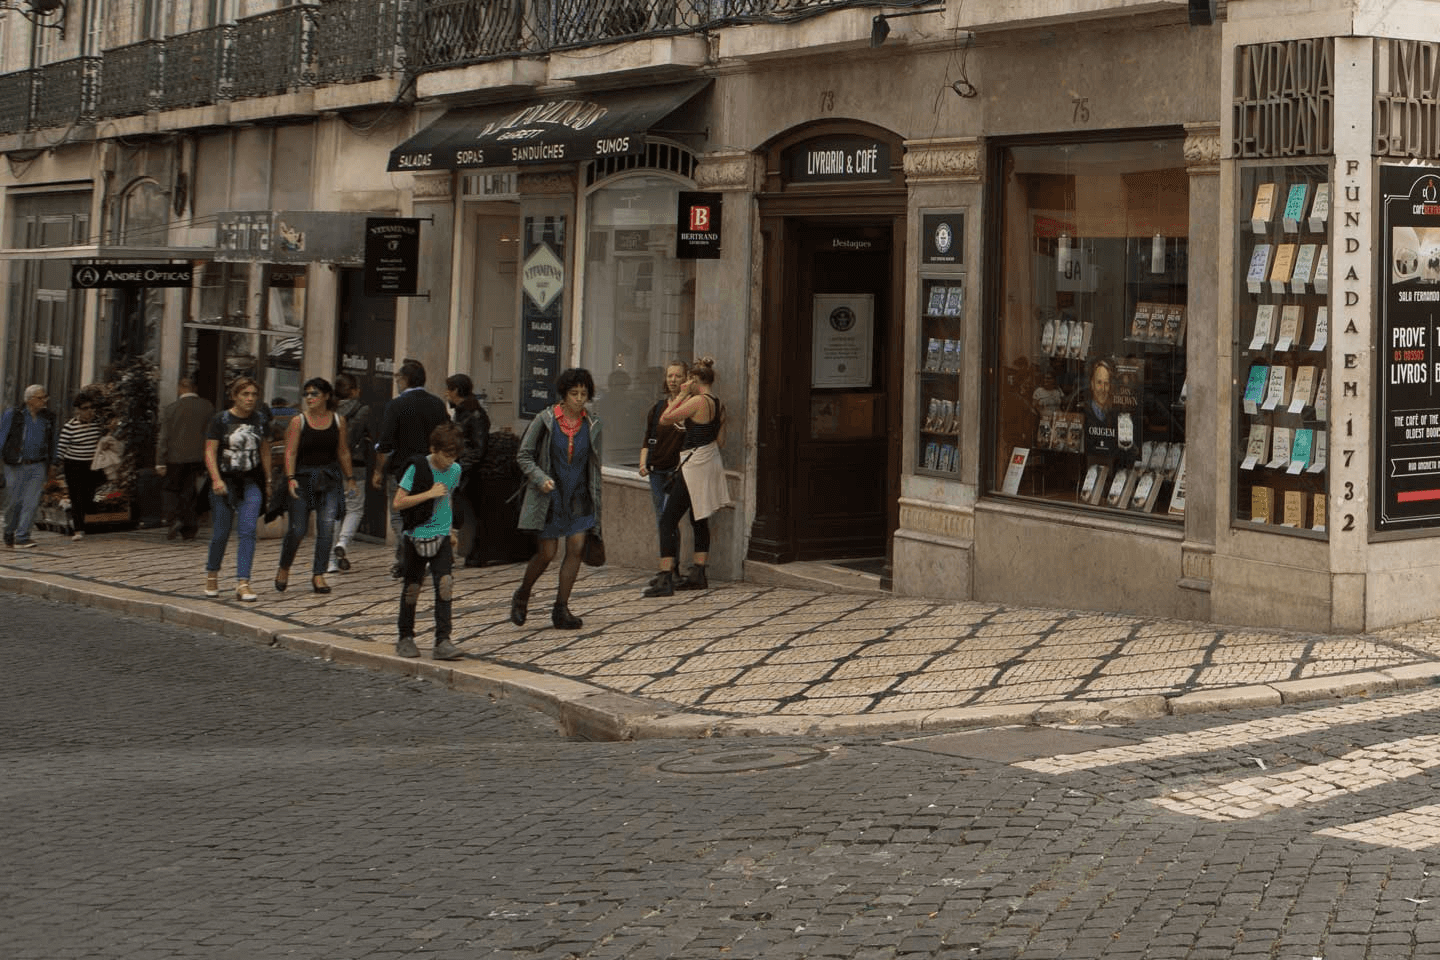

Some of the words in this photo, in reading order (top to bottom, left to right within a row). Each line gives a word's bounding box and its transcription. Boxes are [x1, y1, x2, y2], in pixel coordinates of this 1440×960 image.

[1233, 38, 1334, 102] LIVRARIA
[820, 91, 834, 112] 73
[1071, 98, 1089, 124] 75
[1232, 94, 1335, 158] BERTRAND
[398, 153, 432, 168] SALADAS
[456, 149, 484, 165] SOPAS
[511, 141, 565, 161] SANDUÍCHES
[595, 136, 630, 155] SUMOS
[807, 149, 845, 175] LIVRARIA
[846, 155, 854, 174] &
[855, 144, 878, 174] CAFÉ
[681, 233, 719, 241] BERTRAND
[832, 239, 872, 250] Destaques
[1343, 160, 1361, 334] FUNDADA
[103, 269, 143, 281] ANDRÉ
[144, 269, 190, 281] OPTICAS
[524, 264, 562, 281] VITAMINAS
[1398, 291, 1412, 302] SALA
[1413, 290, 1440, 302] FERNANDO
[1392, 326, 1426, 348] PROVE
[1342, 353, 1359, 398] EM
[1391, 362, 1427, 385] LIVROS
[1113, 395, 1138, 407] BROWN
[1394, 416, 1405, 428] THE
[1405, 413, 1419, 427] CAFÉ
[1420, 414, 1428, 426] OF
[1429, 414, 1439, 425] THE
[1088, 426, 1116, 438] ORIGEM
[1405, 427, 1425, 440] OLDEST
[1341, 417, 1356, 532] 1732
